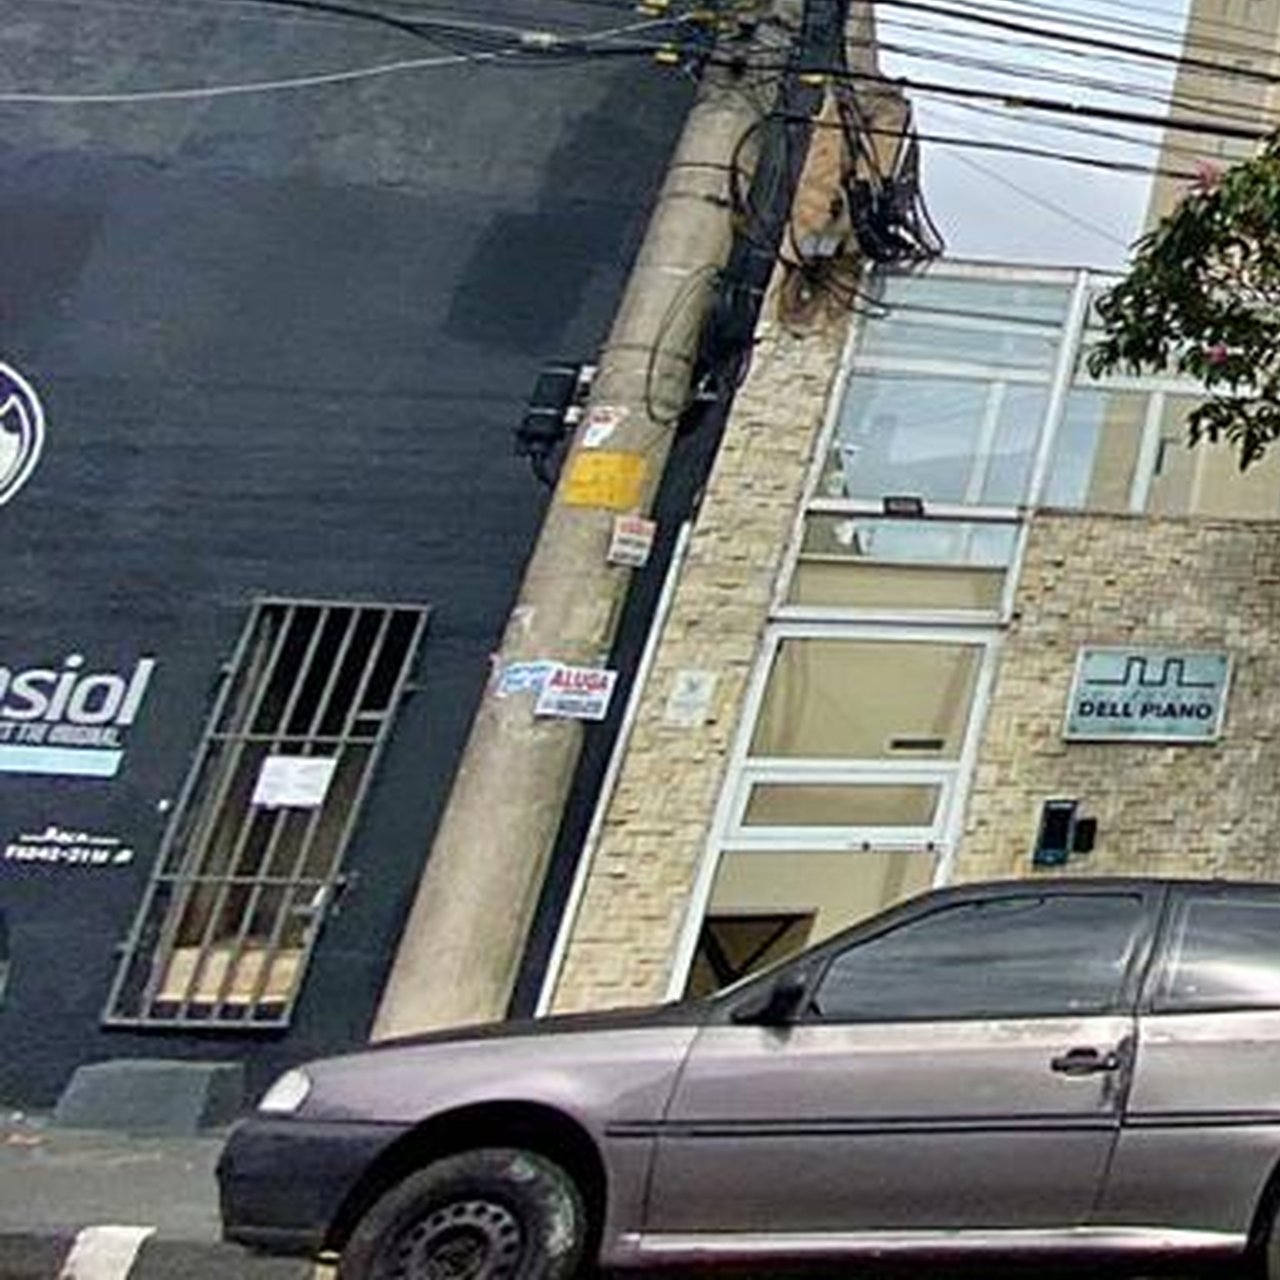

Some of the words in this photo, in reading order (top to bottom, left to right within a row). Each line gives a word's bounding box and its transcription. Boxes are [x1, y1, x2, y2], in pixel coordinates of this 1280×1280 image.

[549, 668, 609, 690] ALUGA
[1078, 701, 1133, 719] DELL
[1139, 702, 1213, 721] PIANO
